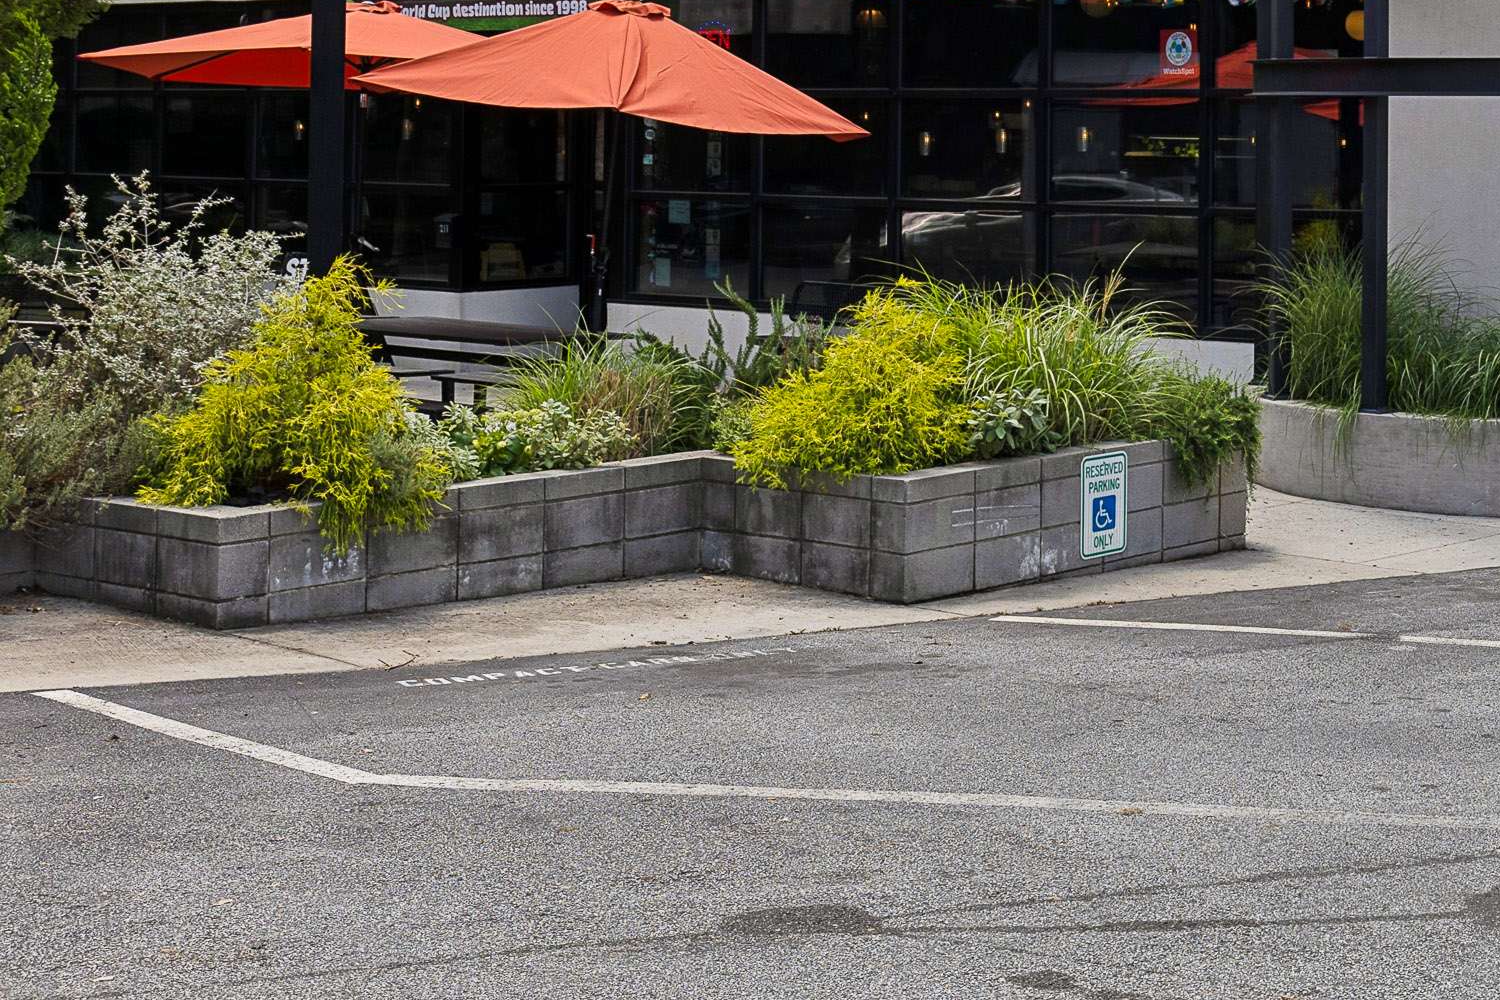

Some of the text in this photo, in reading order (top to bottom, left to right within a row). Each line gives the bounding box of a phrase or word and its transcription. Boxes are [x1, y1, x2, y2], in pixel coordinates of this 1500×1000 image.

[400, 0, 588, 20] orld Cup destination since 1998
[1085, 461, 1123, 478] RESERVED
[1088, 478, 1120, 494] PARKING
[1093, 533, 1113, 549] ONLY
[396, 665, 591, 688] COMPACT
